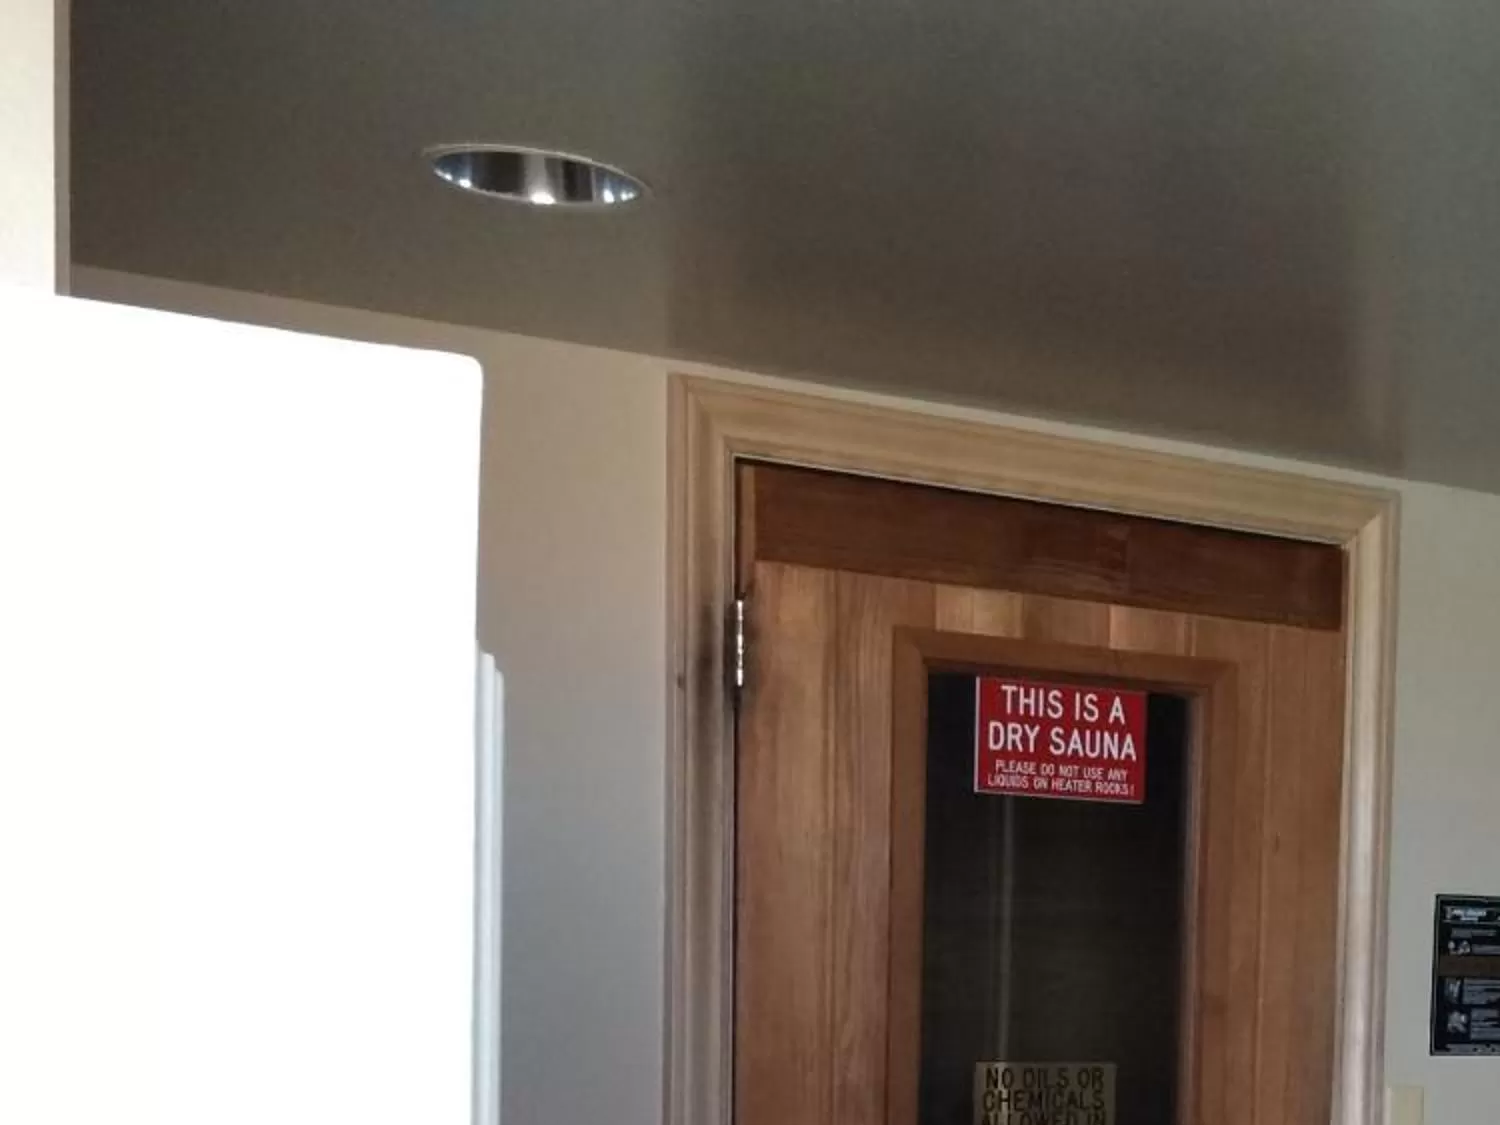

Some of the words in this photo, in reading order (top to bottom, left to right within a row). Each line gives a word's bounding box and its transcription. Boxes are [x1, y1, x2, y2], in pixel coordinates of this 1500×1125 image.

[1001, 685, 1063, 719] THIS
[1074, 691, 1099, 723] IS
[1108, 696, 1125, 725] A
[988, 720, 1040, 753] DRY
[1050, 727, 1137, 762] SAUNA
[995, 760, 1036, 775] PLEASE
[1040, 763, 1055, 776] DO
[1059, 764, 1079, 777] NOT
[1083, 767, 1104, 780] USE
[1108, 768, 1128, 782] ANY
[1033, 776, 1048, 790] ON
[1051, 778, 1093, 792] HEATER
[986, 1067, 1014, 1088] NO
[1023, 1067, 1070, 1089] OILS
[1077, 1067, 1105, 1090] OR
[983, 1089, 1105, 1112] CHEMICALS
